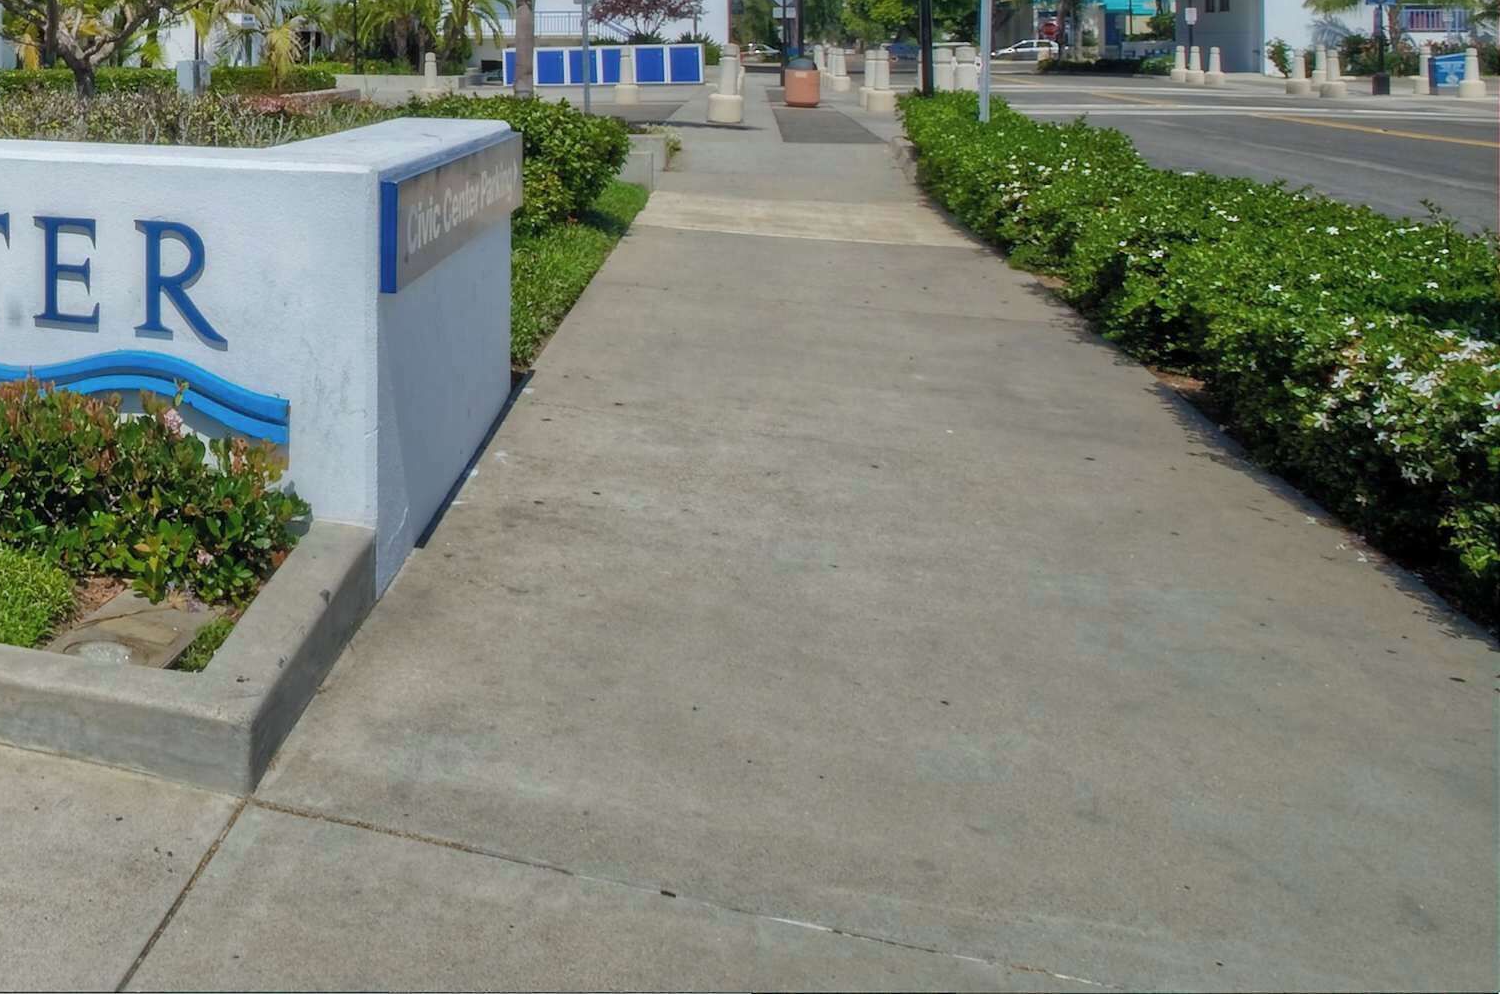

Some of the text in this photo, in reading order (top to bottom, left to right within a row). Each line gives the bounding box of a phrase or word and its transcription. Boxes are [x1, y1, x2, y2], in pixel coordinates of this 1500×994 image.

[407, 162, 514, 255] Civic Center Parking
